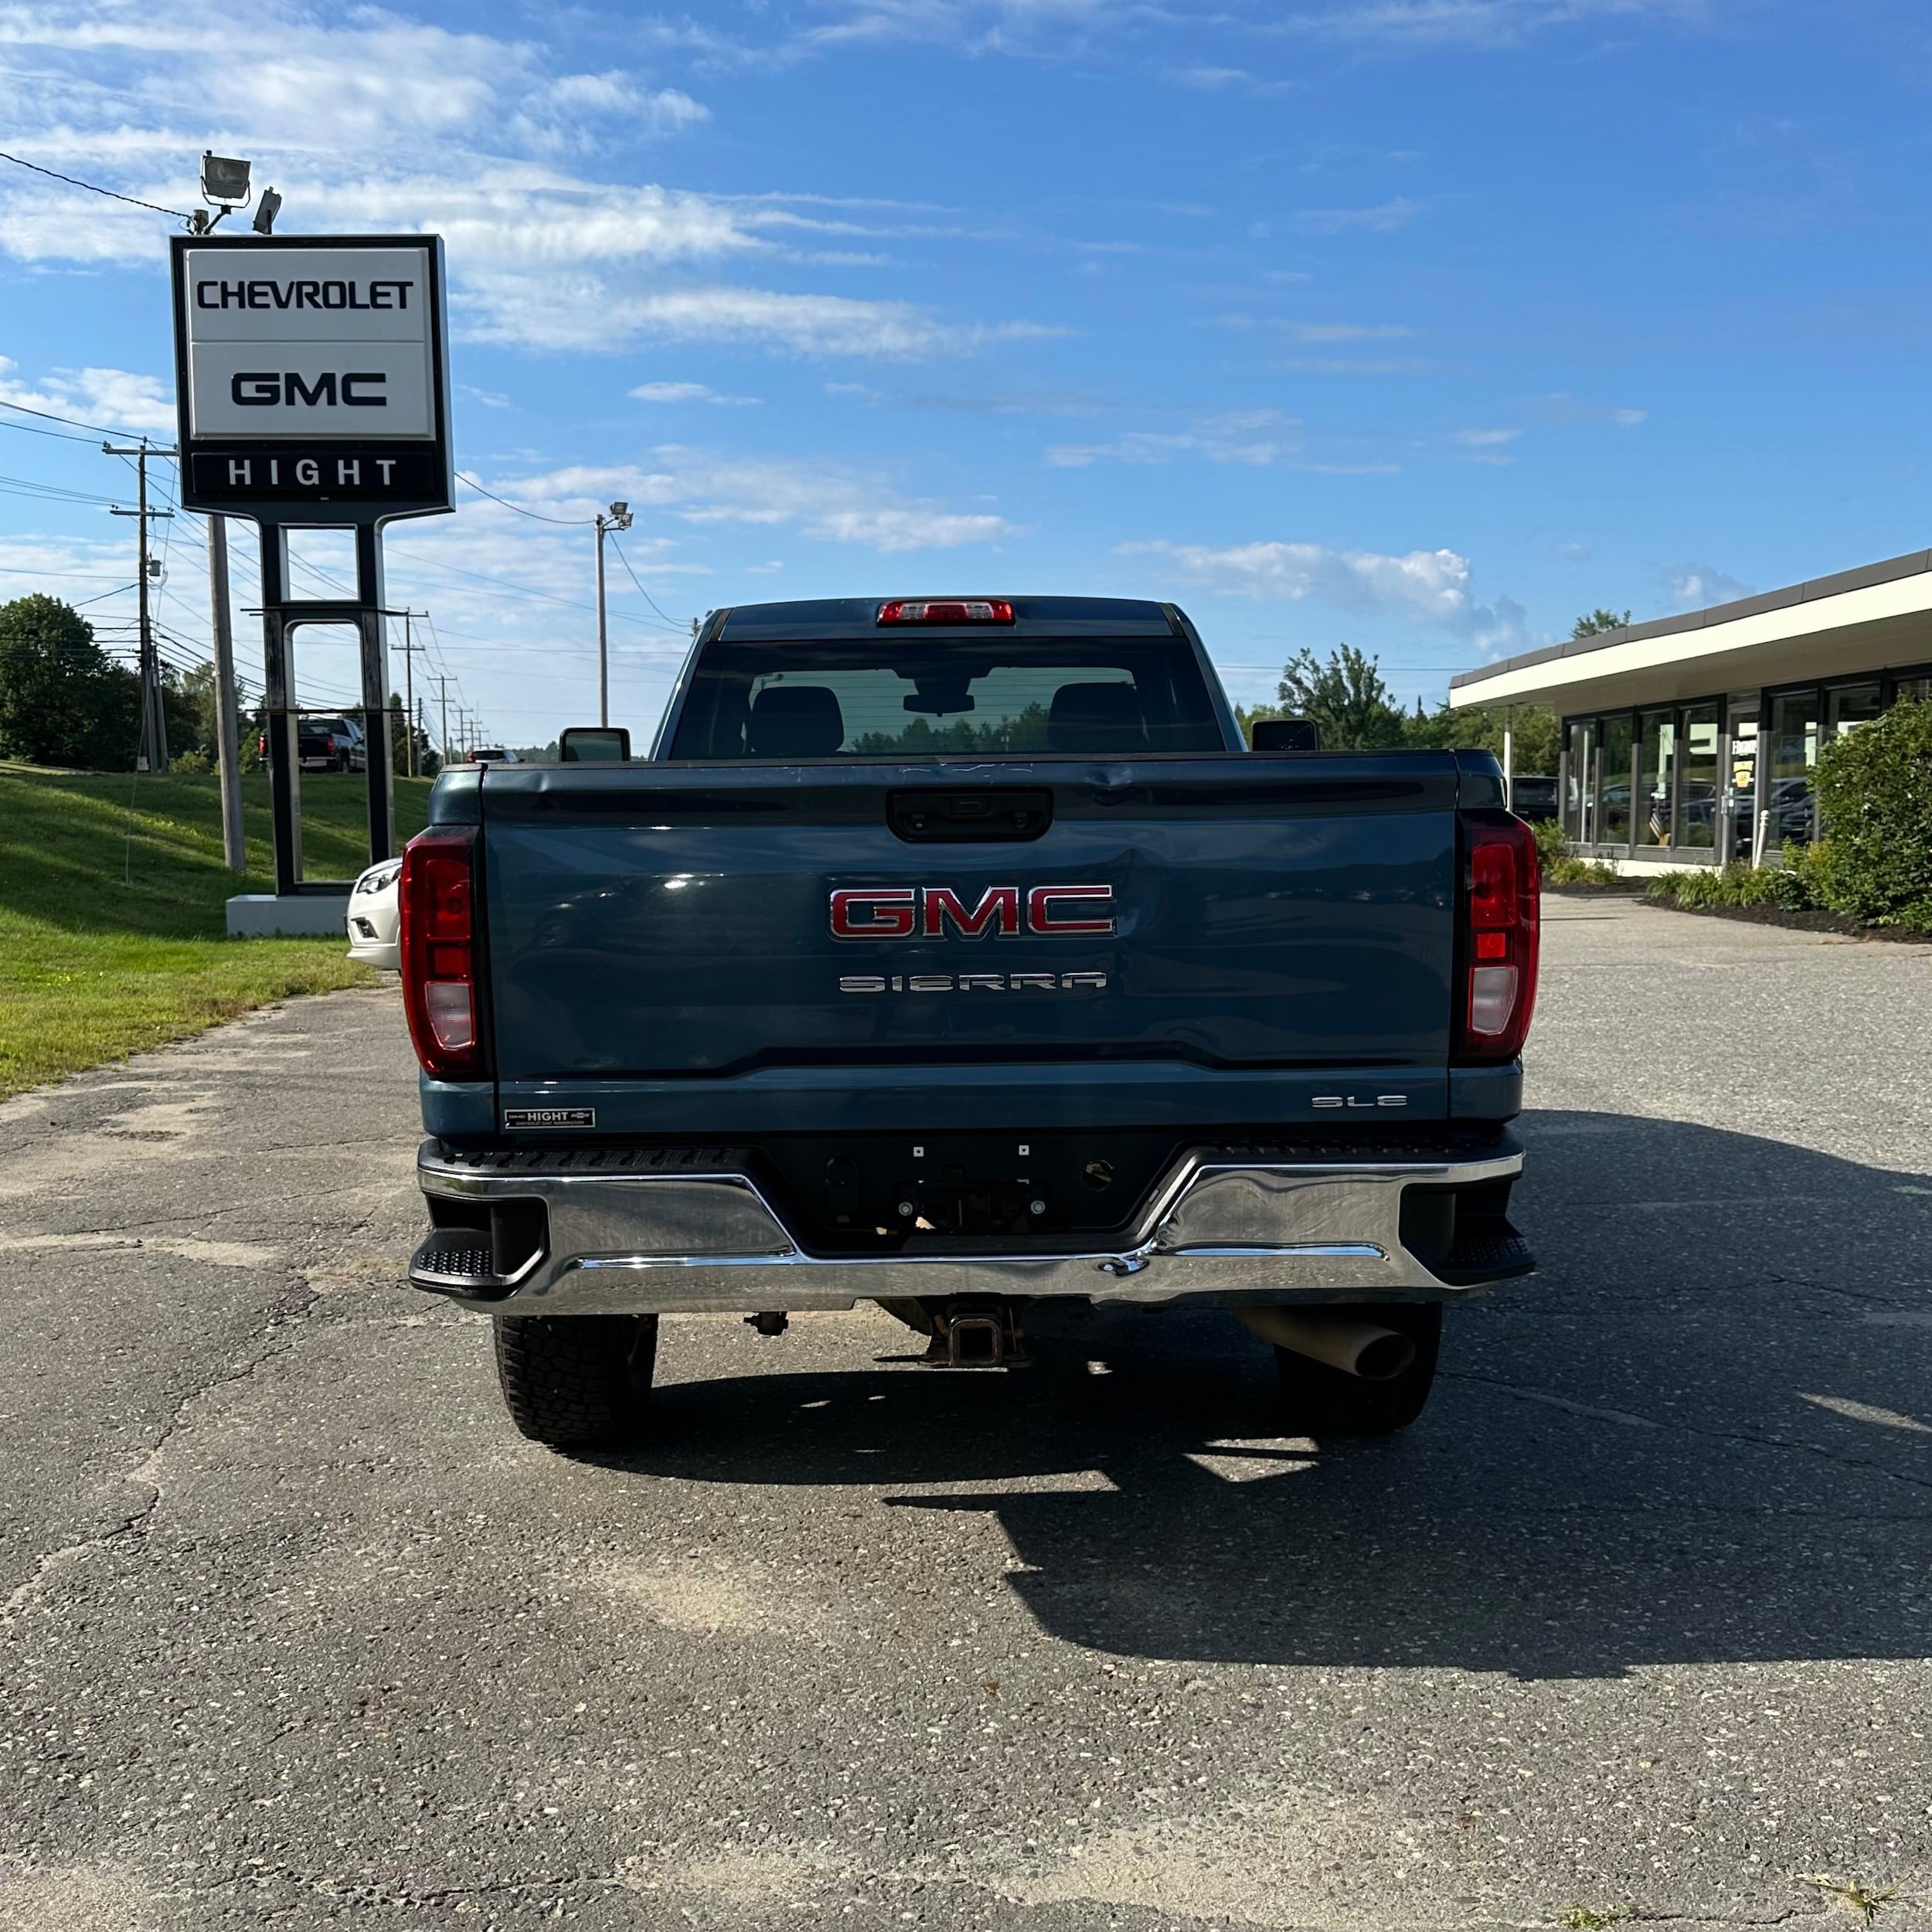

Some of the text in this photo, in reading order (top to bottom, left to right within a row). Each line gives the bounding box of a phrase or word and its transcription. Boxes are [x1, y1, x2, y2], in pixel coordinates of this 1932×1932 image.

[196, 281, 414, 309] CHEVROLET
[231, 372, 387, 406] GMC
[228, 459, 396, 486] HIGHT
[830, 884, 1114, 938] GMC
[839, 971, 1107, 992] SIERRA
[1311, 1095, 1408, 1108] SLE
[527, 1111, 569, 1121] HIGHT
